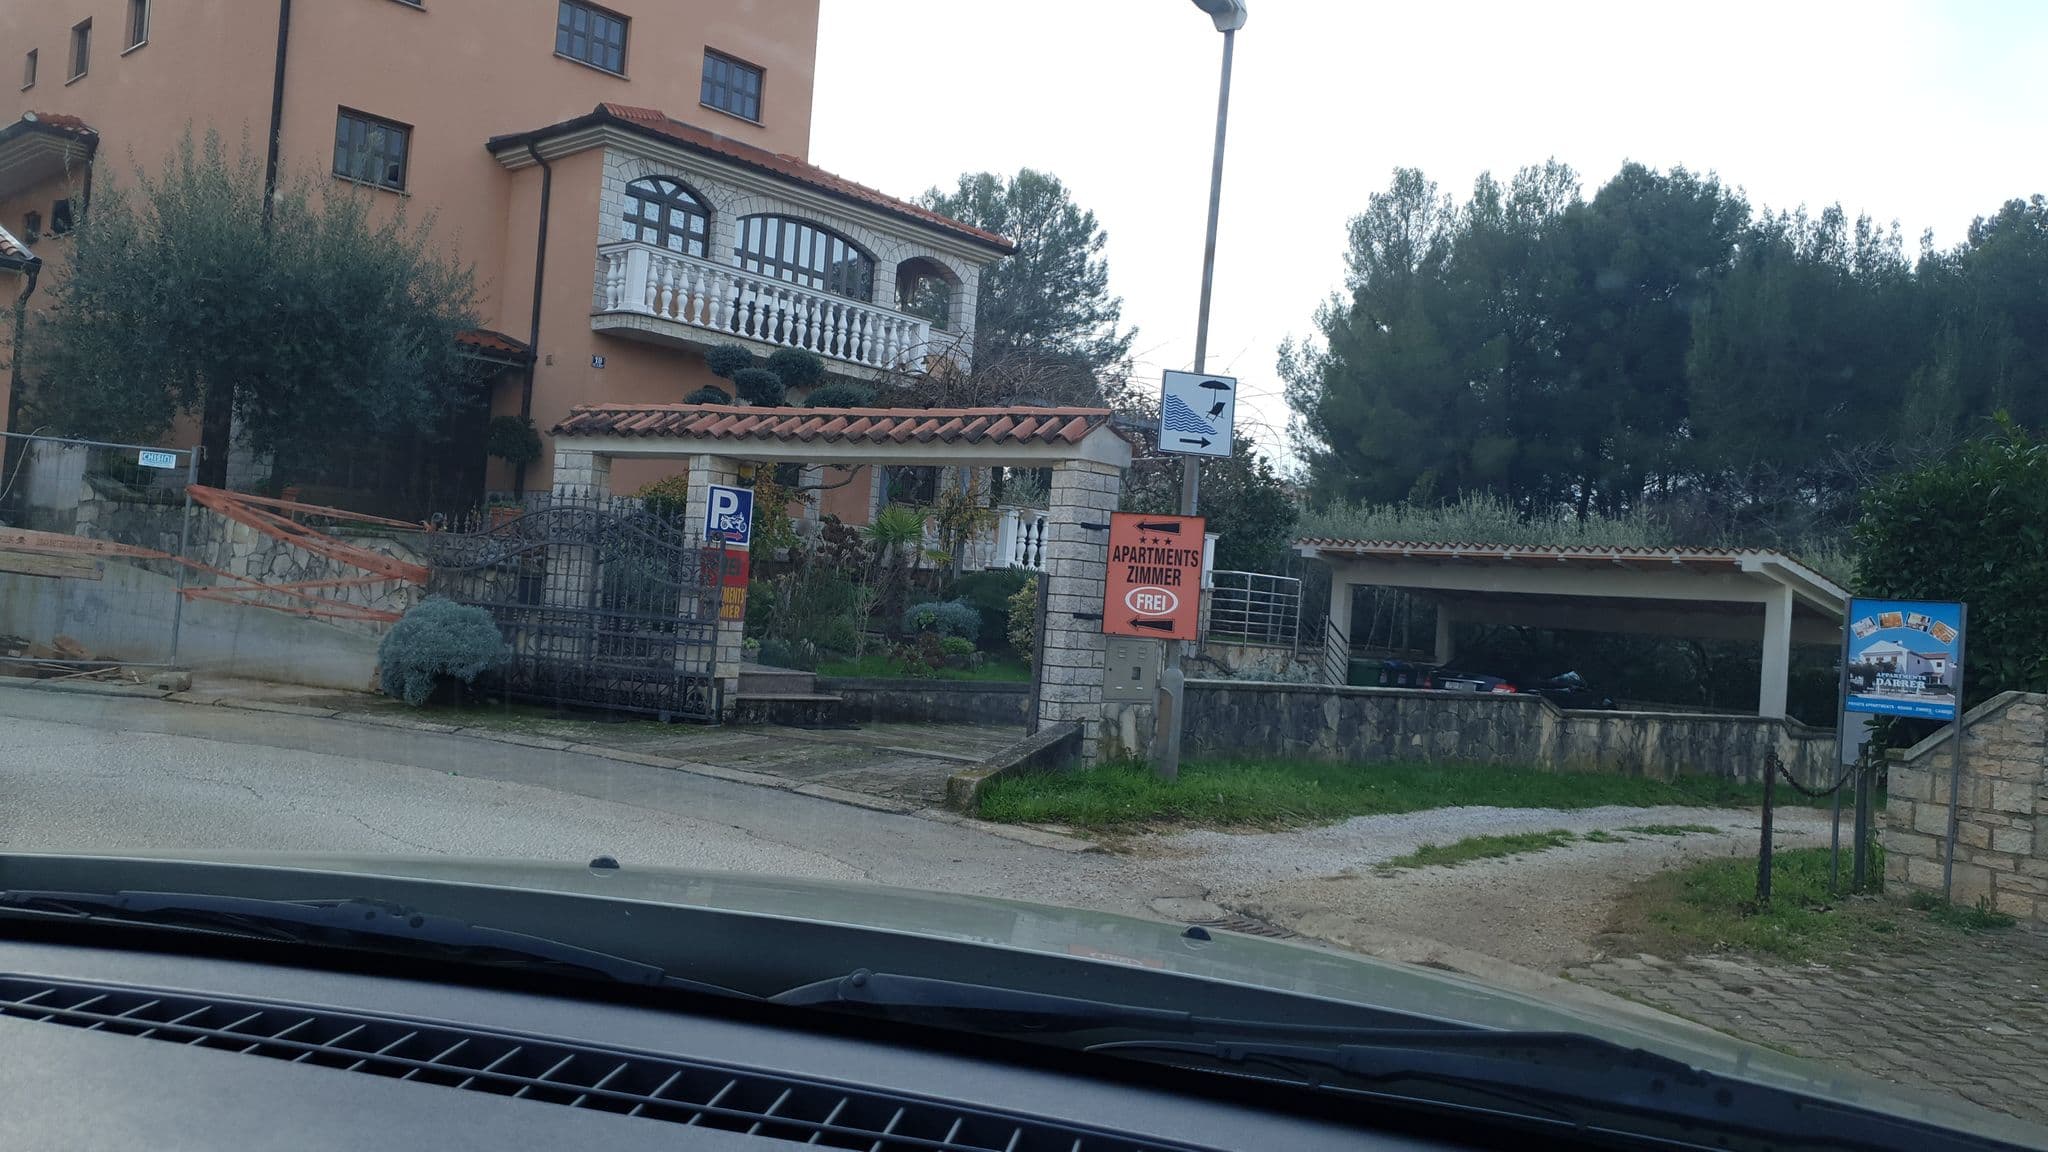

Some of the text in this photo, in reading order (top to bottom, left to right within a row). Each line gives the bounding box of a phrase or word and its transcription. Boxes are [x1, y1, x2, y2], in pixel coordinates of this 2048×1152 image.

[710, 489, 738, 529] P
[1112, 545, 1199, 568] APARTMENTS
[1126, 565, 1182, 587] ZIMMER
[722, 586, 746, 605] MENTS
[1136, 593, 1167, 611] FREI
